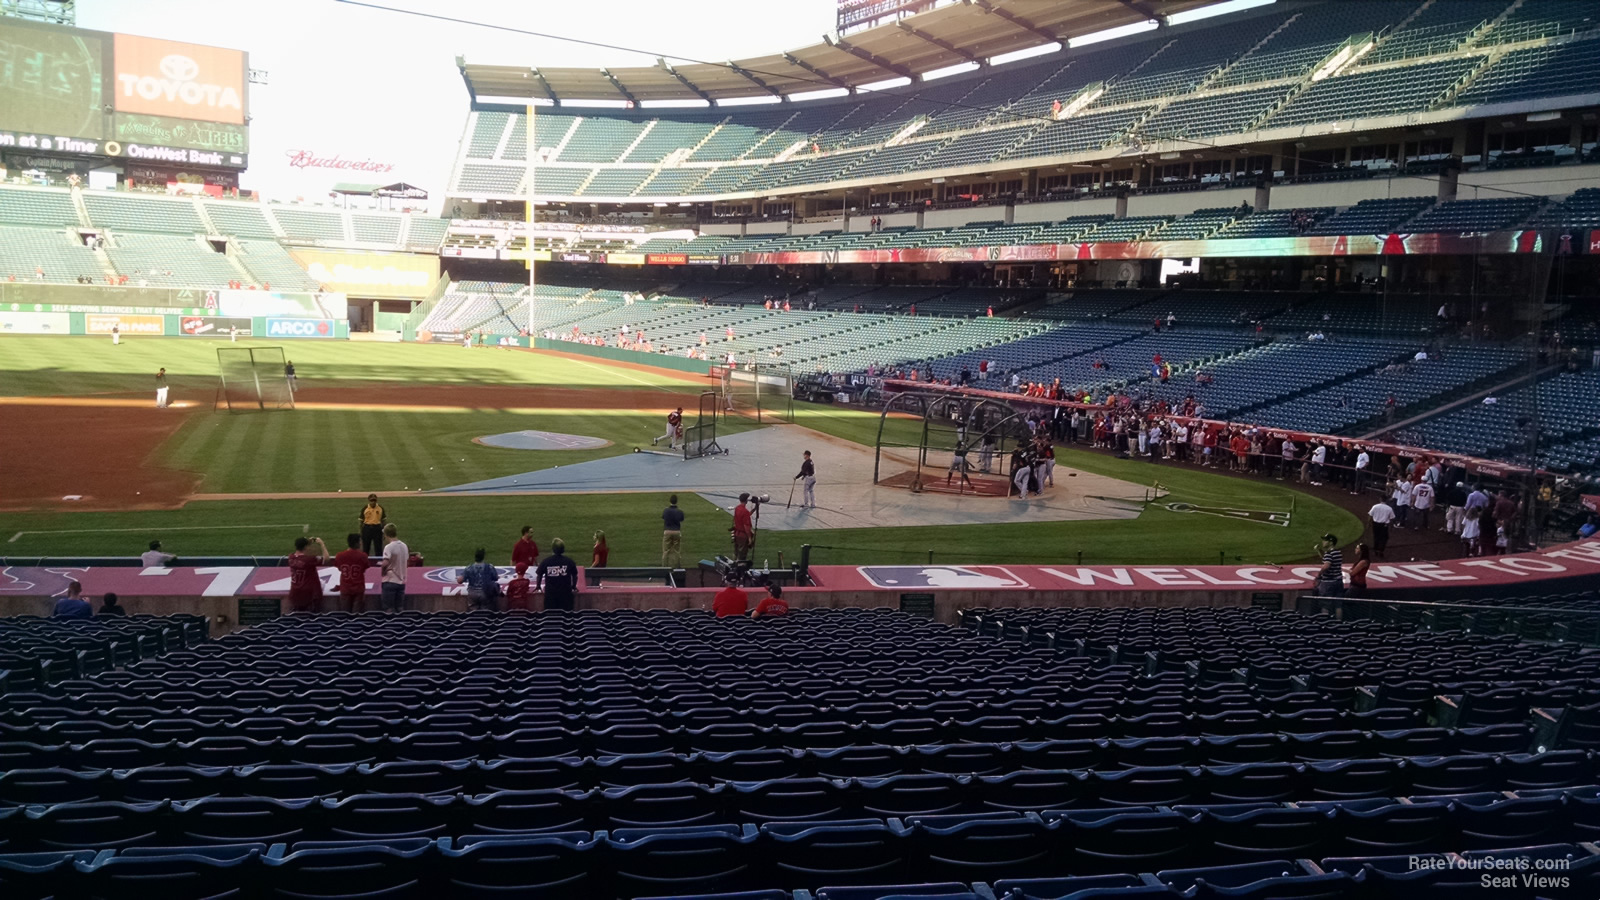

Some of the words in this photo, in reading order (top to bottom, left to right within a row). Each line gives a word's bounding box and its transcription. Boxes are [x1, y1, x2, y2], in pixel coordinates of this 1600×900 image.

[118, 73, 240, 110] TOYOTA
[19, 136, 37, 148] at
[41, 138, 51, 149] a
[55, 137, 98, 152] Time
[188, 123, 241, 147] ANGELS
[128, 144, 188, 162] OneWest
[190, 150, 223, 165] Bank
[285, 149, 395, 173] Budweiser
[270, 320, 313, 335] ARCO
[1419, 490, 1429, 498] 27
[340, 564, 361, 580] 36
[1459, 557, 1567, 576] TO
